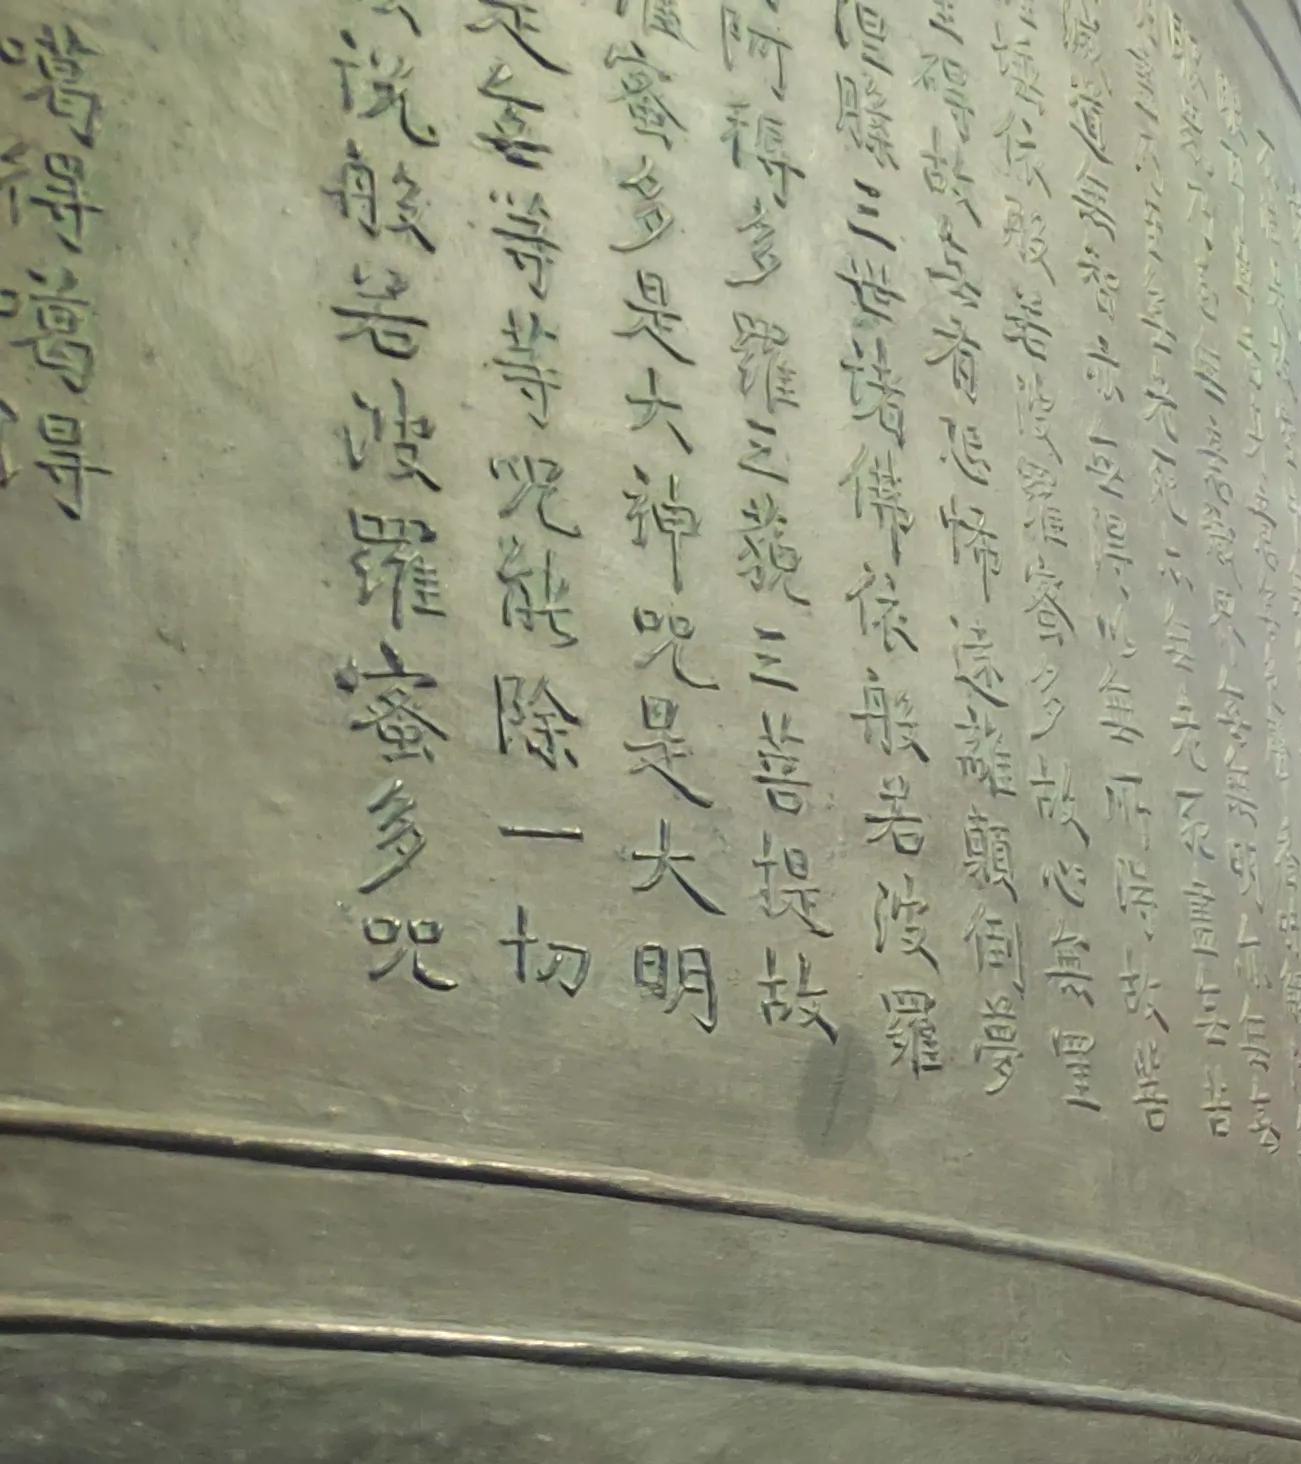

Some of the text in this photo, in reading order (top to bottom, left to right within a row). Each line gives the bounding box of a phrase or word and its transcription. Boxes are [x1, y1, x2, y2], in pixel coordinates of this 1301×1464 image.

[719, 0, 838, 1044] 阿耨多羅三藐三菩提故
[990, 0, 1100, 1112] 埵依般若波羅蜜多故心無罣
